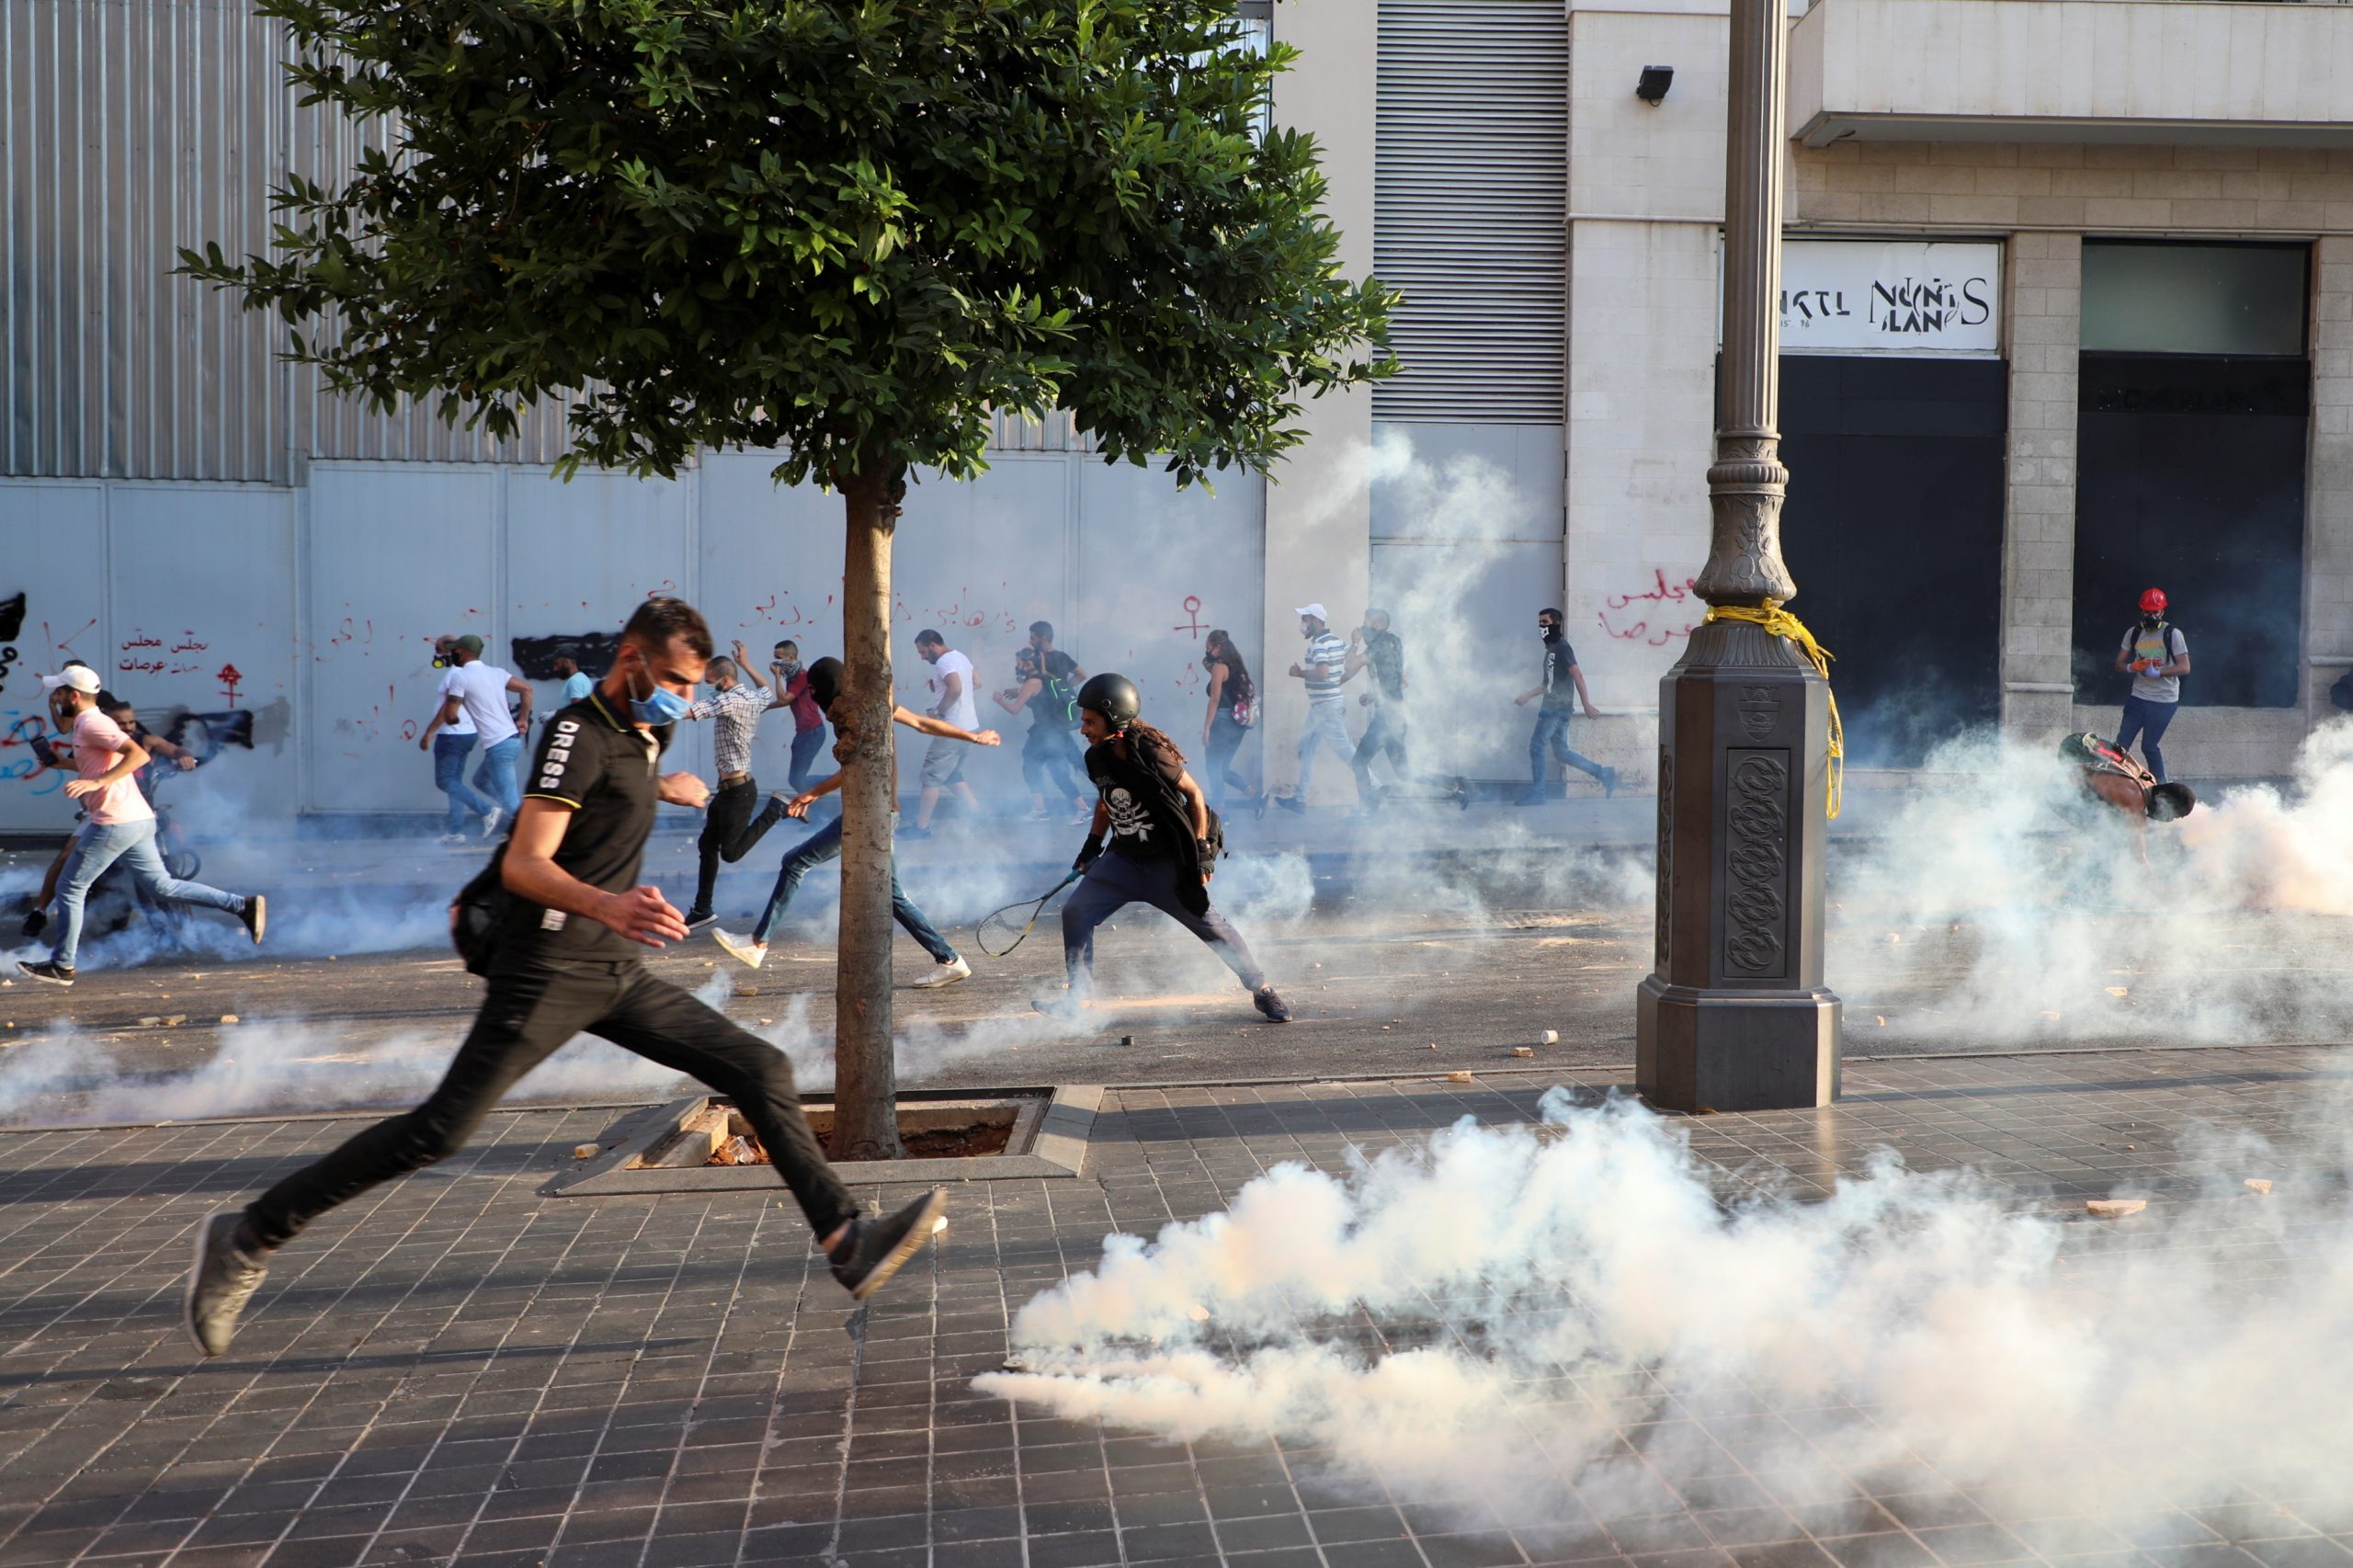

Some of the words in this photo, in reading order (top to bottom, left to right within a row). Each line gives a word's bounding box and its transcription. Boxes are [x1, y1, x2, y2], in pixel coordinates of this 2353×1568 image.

[121, 633, 162, 650] مجلس
[119, 657, 165, 675] عرصات
[539, 721, 581, 789] DRESS
